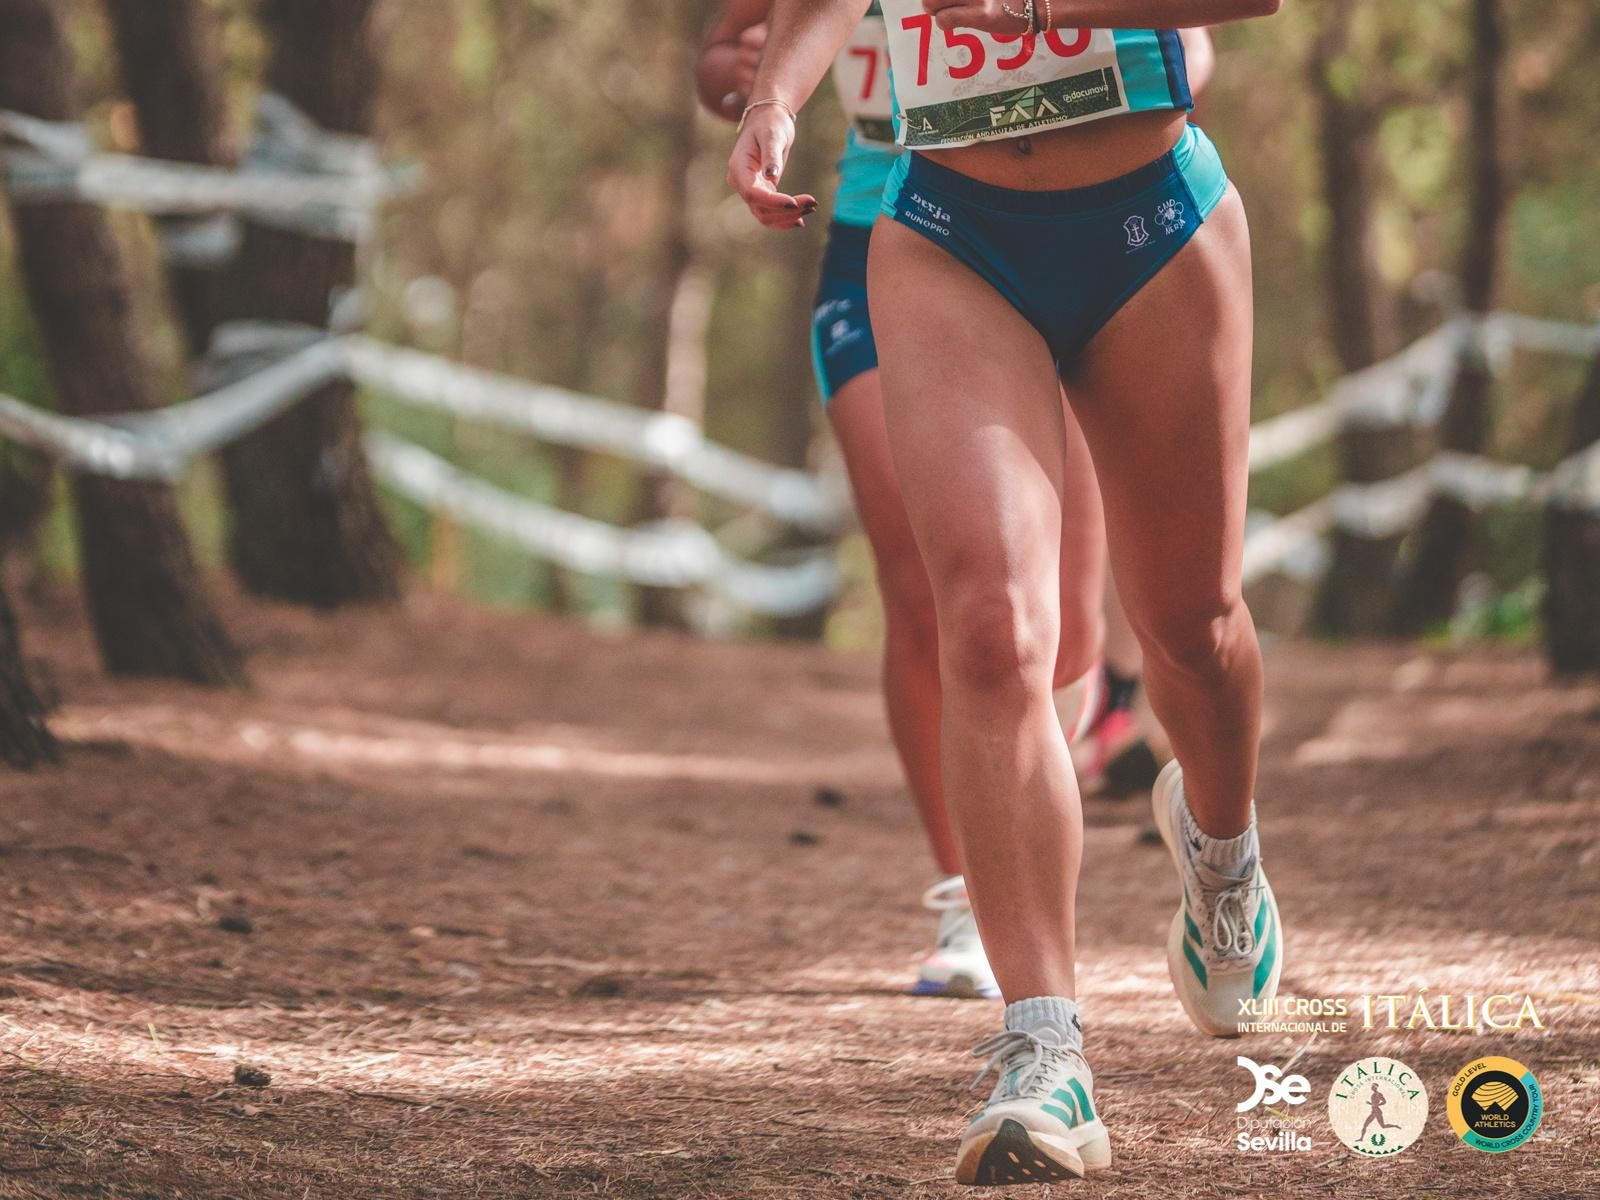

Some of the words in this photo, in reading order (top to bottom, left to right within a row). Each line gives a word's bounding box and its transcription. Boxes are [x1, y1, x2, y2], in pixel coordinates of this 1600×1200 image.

[848, 46, 892, 102] 7
[1016, 123, 1026, 131] DE
[1028, 114, 1068, 129] ATLETISMO
[910, 192, 951, 223] nerja
